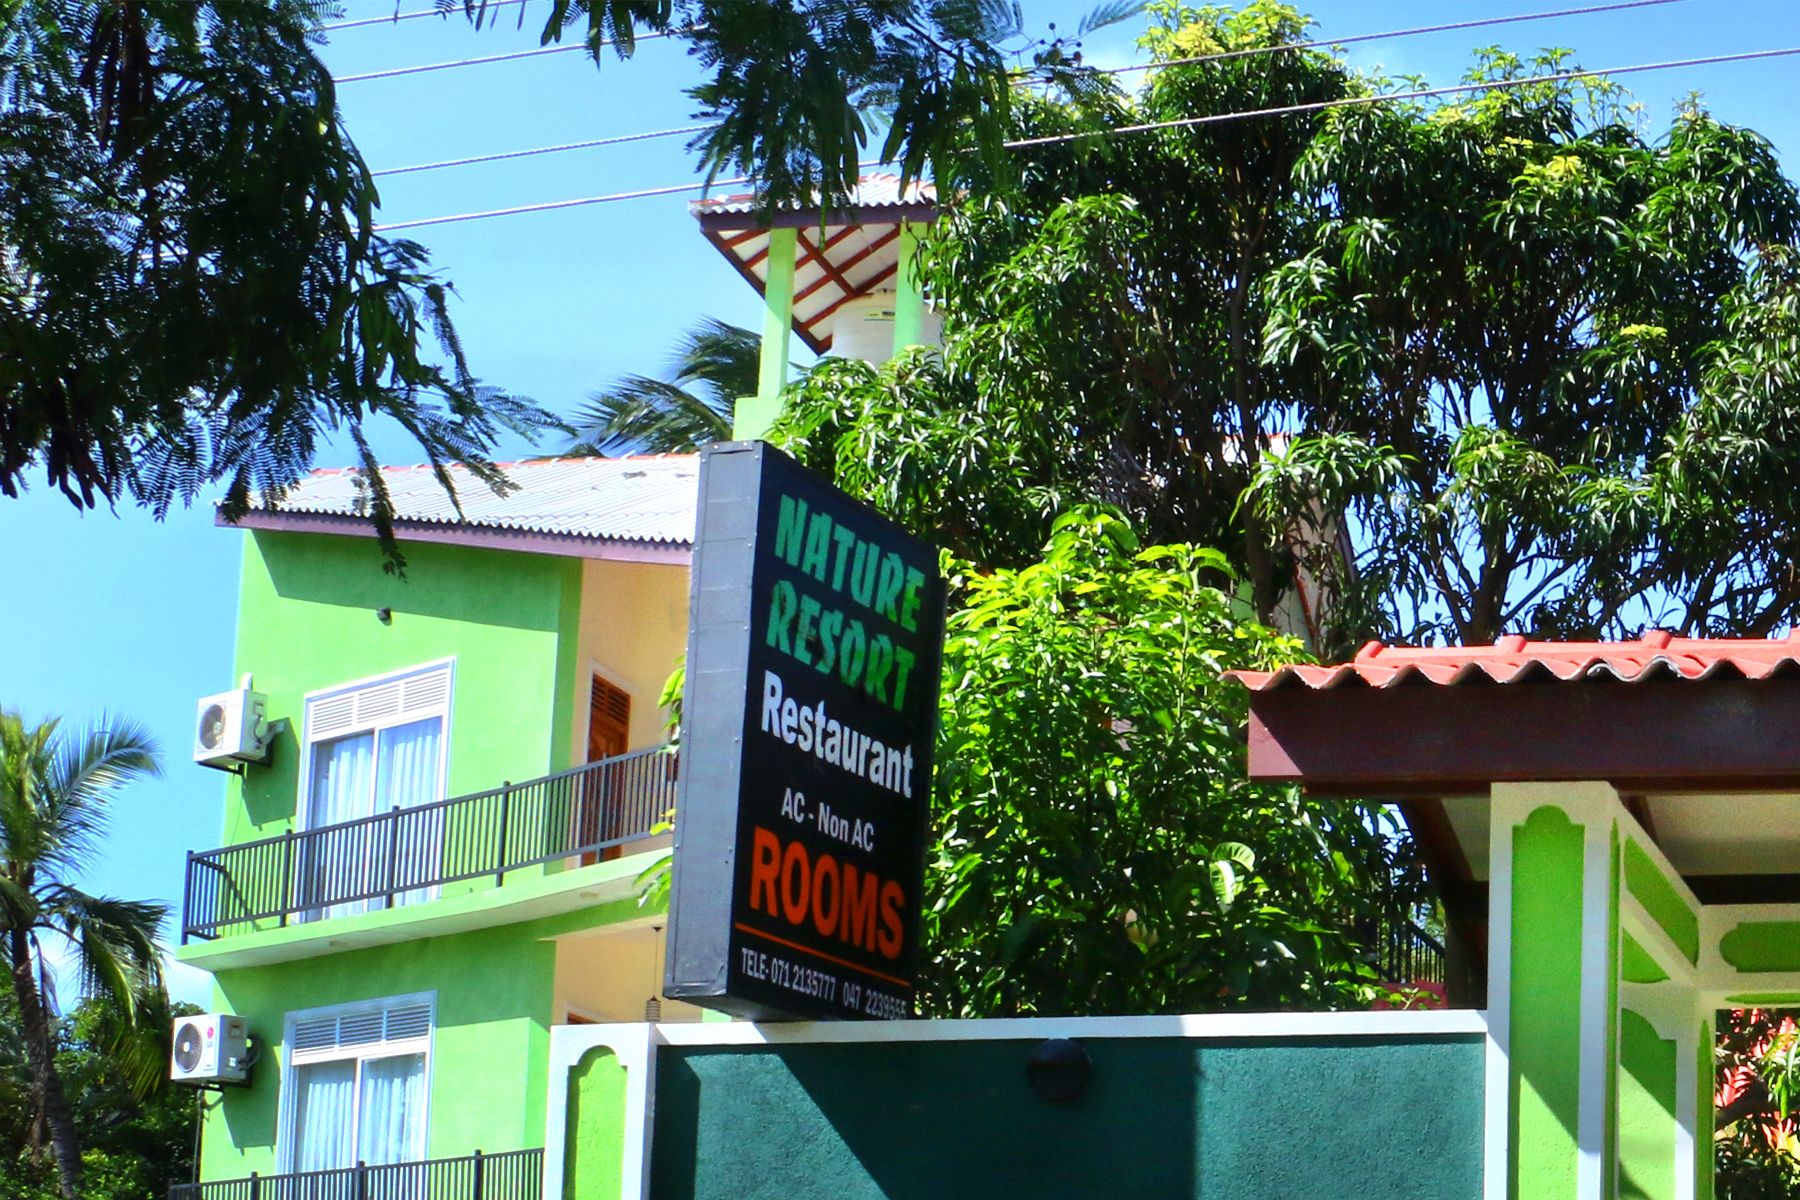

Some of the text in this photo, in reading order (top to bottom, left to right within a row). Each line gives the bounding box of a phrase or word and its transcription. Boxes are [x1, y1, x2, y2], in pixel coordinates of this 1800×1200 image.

[775, 494, 925, 632] NATURE
[766, 579, 915, 711] RESORT
[761, 669, 914, 799] Restaurant
[781, 787, 805, 823] AC
[818, 802, 849, 842] Non
[852, 818, 874, 852] AC
[750, 825, 905, 959] ROOMS
[771, 957, 790, 988] 071
[792, 965, 837, 1001] 2135777
[843, 982, 861, 1010] 047
